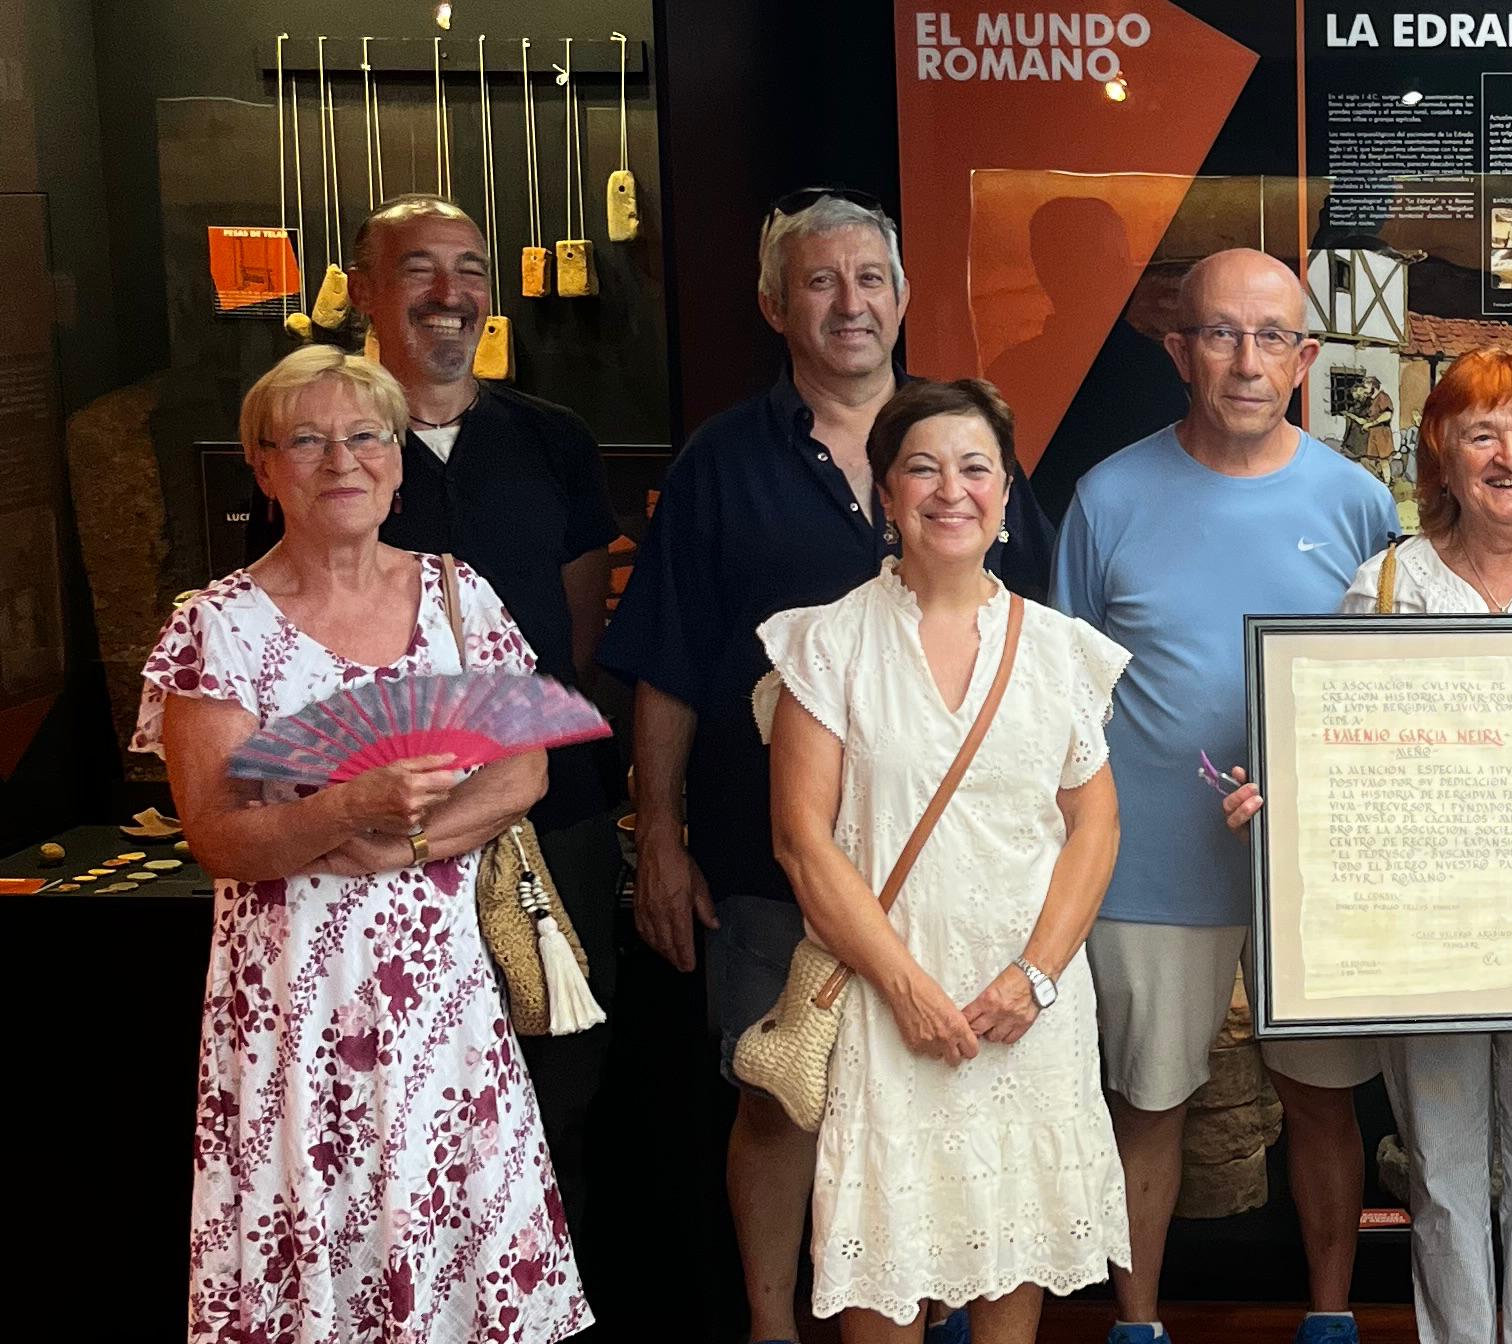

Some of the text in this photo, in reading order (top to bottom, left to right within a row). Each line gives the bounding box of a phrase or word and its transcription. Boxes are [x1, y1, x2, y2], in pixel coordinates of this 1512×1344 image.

[916, 13, 1151, 47] EL MUNDO
[1327, 14, 1378, 47] LA
[917, 48, 1121, 81] ROMANO
